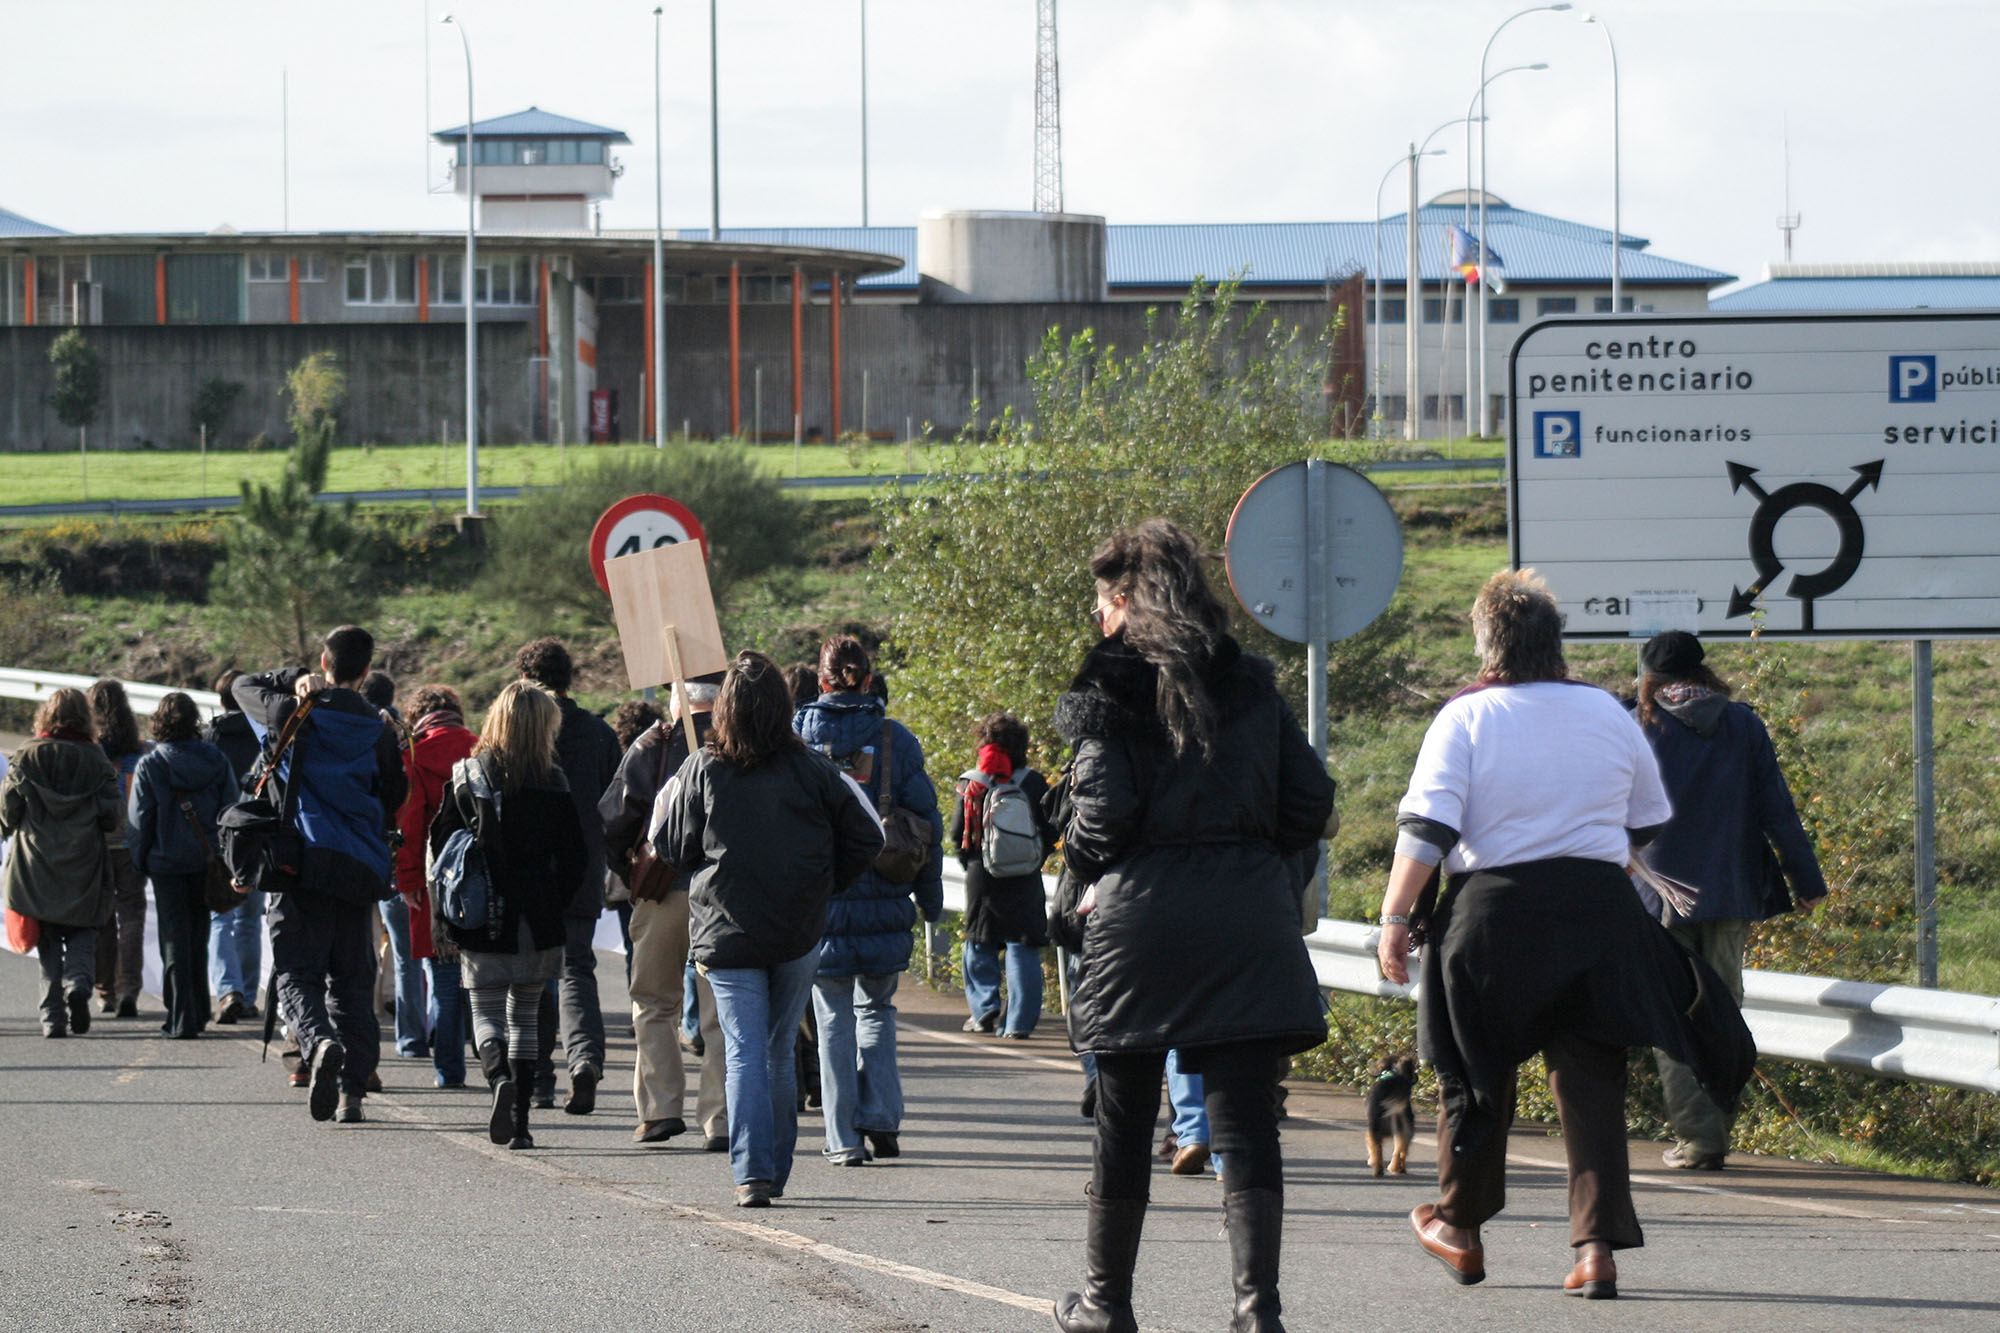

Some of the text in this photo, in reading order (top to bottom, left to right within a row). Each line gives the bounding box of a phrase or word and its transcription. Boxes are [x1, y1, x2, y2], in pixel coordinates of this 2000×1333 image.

[1585, 335, 1696, 360] centro
[1529, 365, 1753, 399] penitenciario
[1898, 361, 1928, 399] P
[1543, 417, 1751, 454] P funcionarios
[1884, 419, 1998, 445] servici
